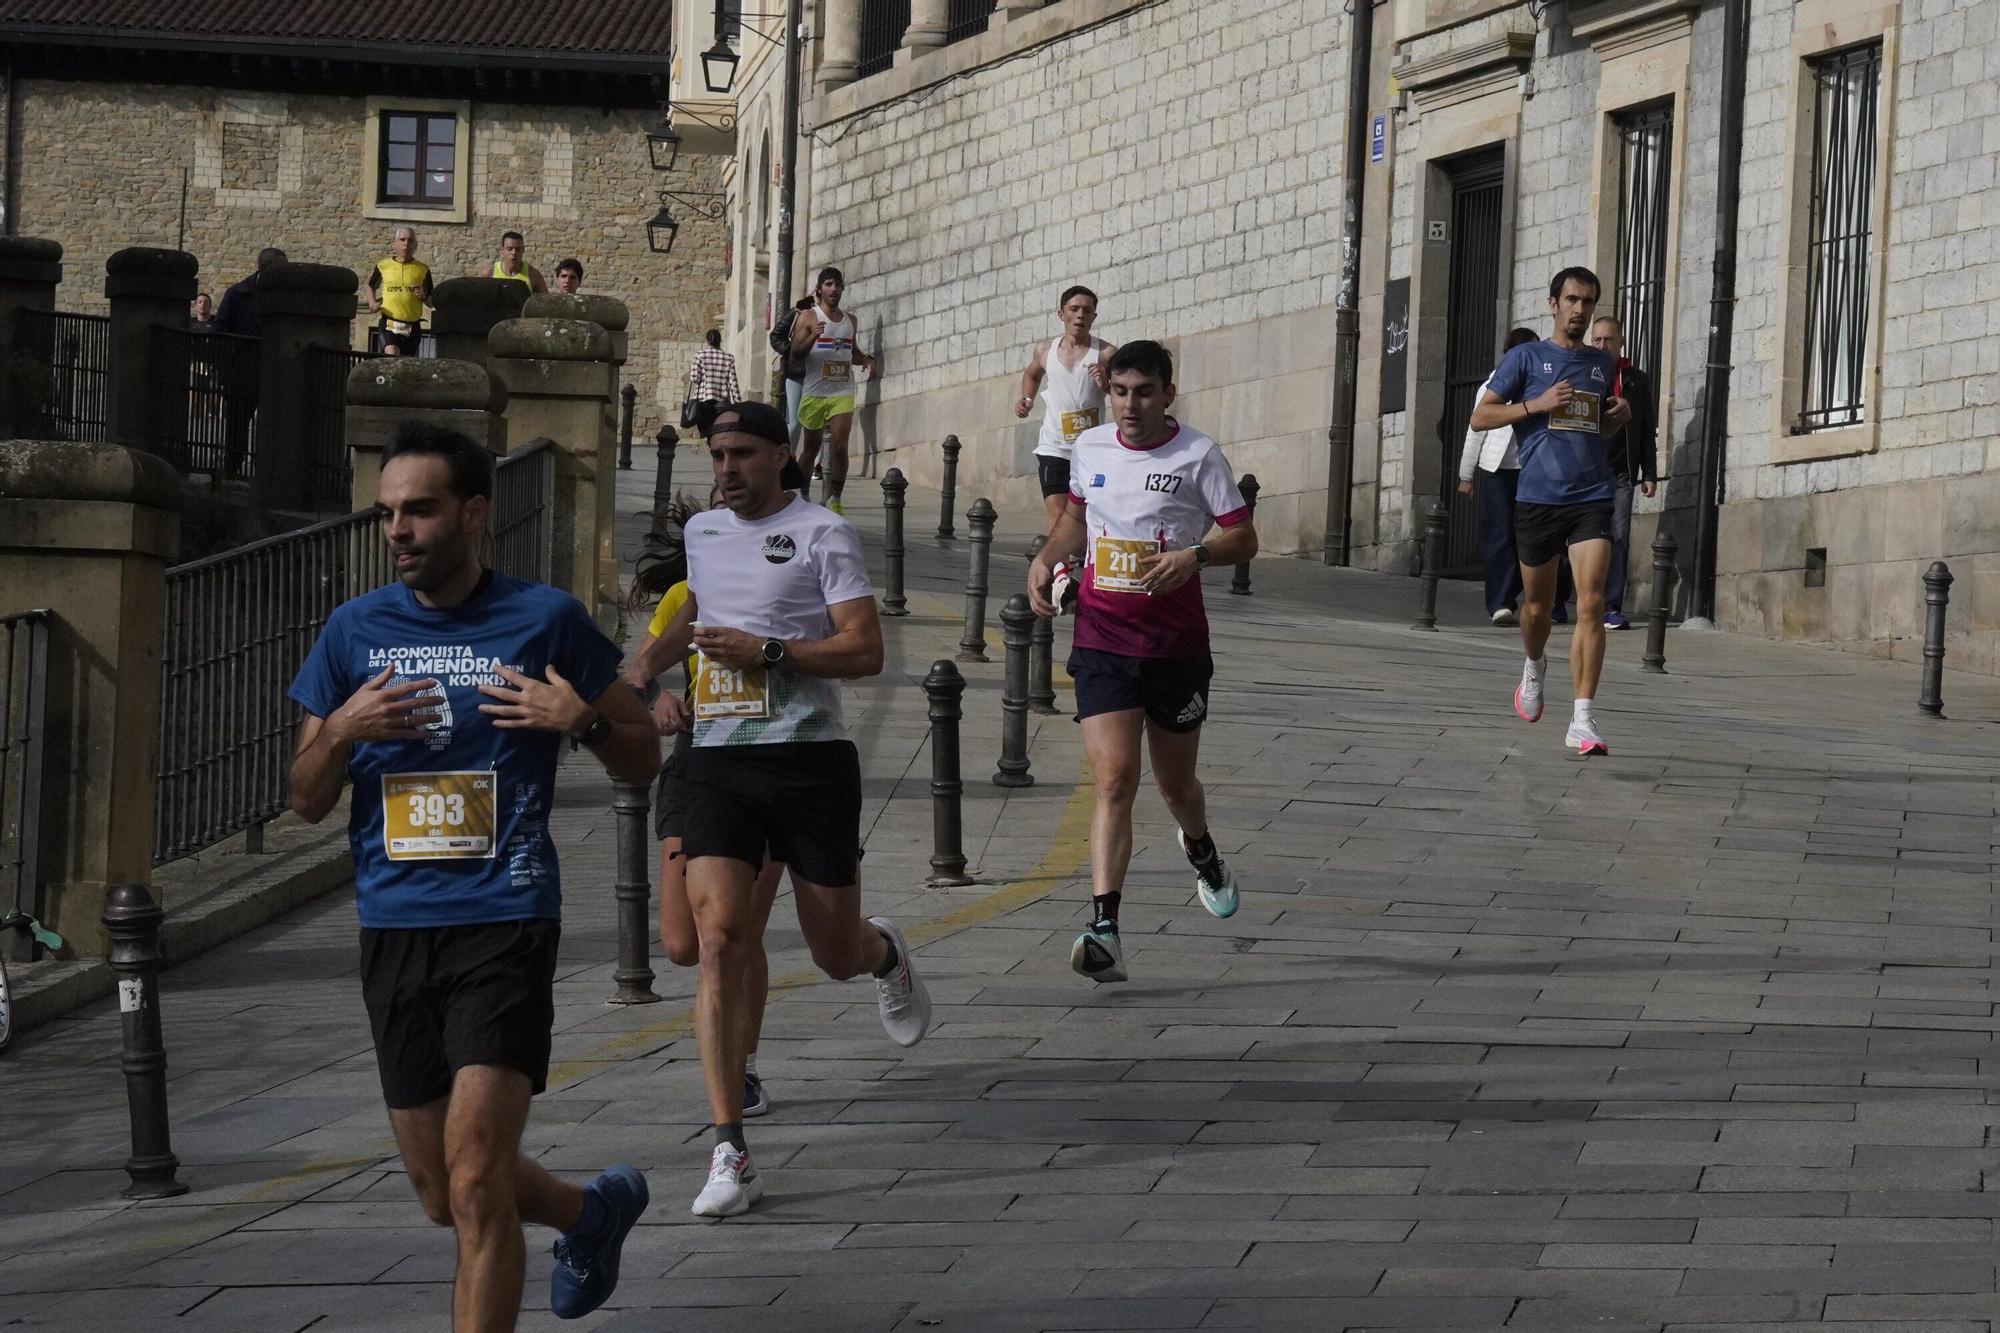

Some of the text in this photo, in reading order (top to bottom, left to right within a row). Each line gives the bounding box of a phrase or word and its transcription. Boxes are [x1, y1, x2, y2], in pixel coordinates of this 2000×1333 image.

[1432, 223, 1443, 237] 5
[1145, 473, 1182, 494] 1327
[1109, 551, 1136, 573] 211
[369, 646, 473, 659] LA CONQUISTA
[394, 657, 502, 674] ALMENDRA
[710, 669, 743, 694] 331
[473, 779, 488, 789] 10K
[409, 794, 465, 827] 393
